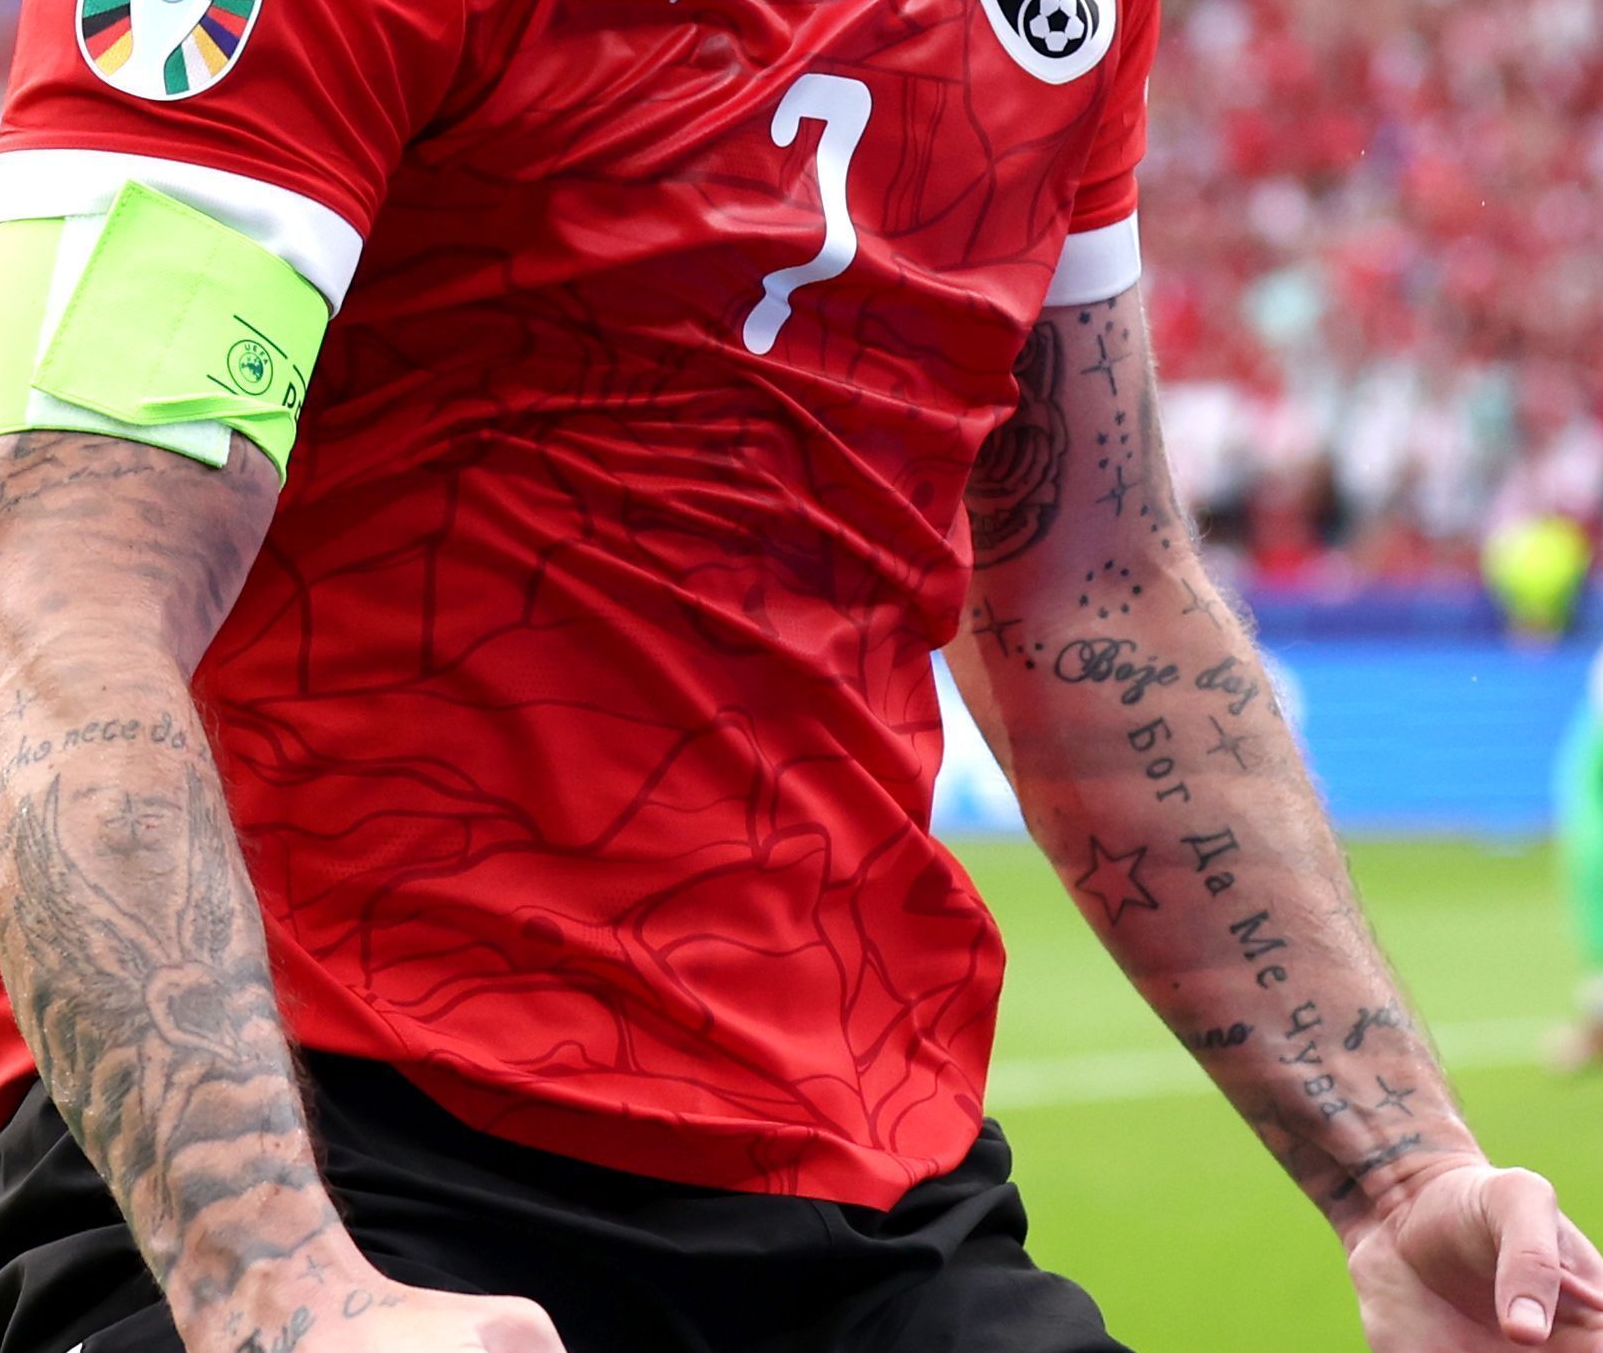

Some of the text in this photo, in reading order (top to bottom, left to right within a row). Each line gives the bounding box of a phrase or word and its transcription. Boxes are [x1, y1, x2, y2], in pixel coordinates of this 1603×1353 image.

[743, 73, 873, 355] 7
[244, 343, 269, 366] UEFA
[1179, 827, 1240, 898] Да
[1229, 909, 1288, 990] Ме
